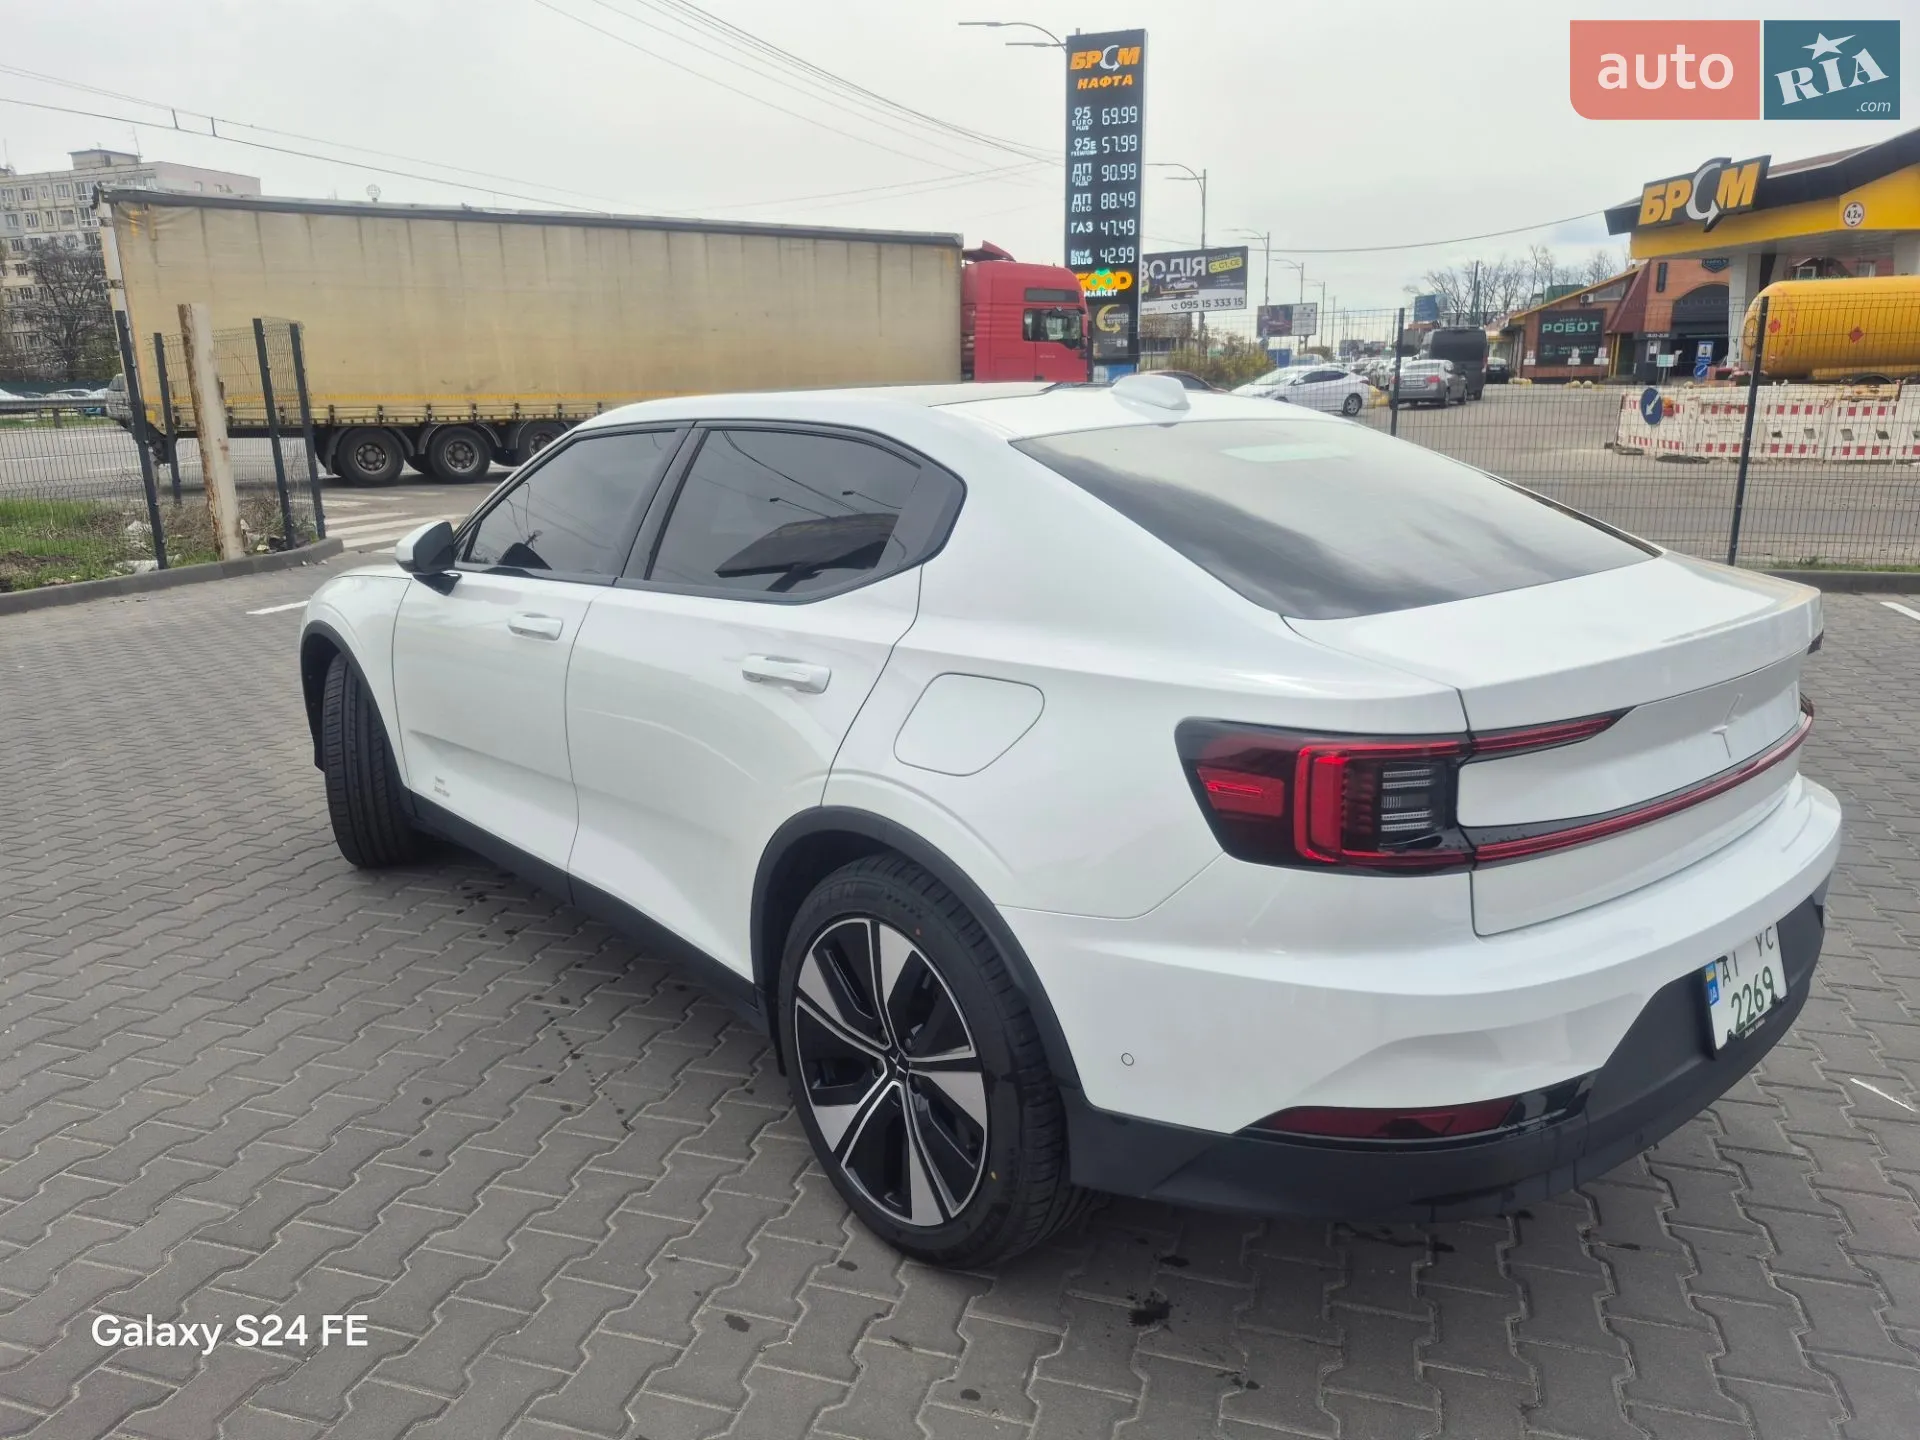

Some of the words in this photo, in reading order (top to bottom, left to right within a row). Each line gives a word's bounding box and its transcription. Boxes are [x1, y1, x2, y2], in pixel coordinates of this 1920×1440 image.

[1076, 74, 1134, 90] НАФТА
[1071, 118, 1093, 127] EURO
[1074, 106, 1091, 120] 95
[1102, 106, 1138, 125] 69.99
[1101, 134, 1137, 154] 57.99
[1072, 163, 1092, 176] ДП
[1101, 163, 1137, 182] 90.99
[1072, 193, 1092, 206] ДП
[1100, 191, 1136, 209] 88.49
[1071, 221, 1094, 234] ГАЗ
[1100, 219, 1135, 236] 47.49
[1070, 255, 1093, 265] Blue
[1100, 246, 1135, 264] 42.99
[1084, 289, 1118, 298] MARKET
[1180, 300, 1198, 309] 095
[1201, 299, 1212, 308] 15
[1214, 298, 1232, 307] 333
[1234, 297, 1244, 306] 15
[1542, 322, 1599, 333] РОБОТ
[1755, 926, 1774, 957] YC
[1731, 966, 1775, 1034] 2269
